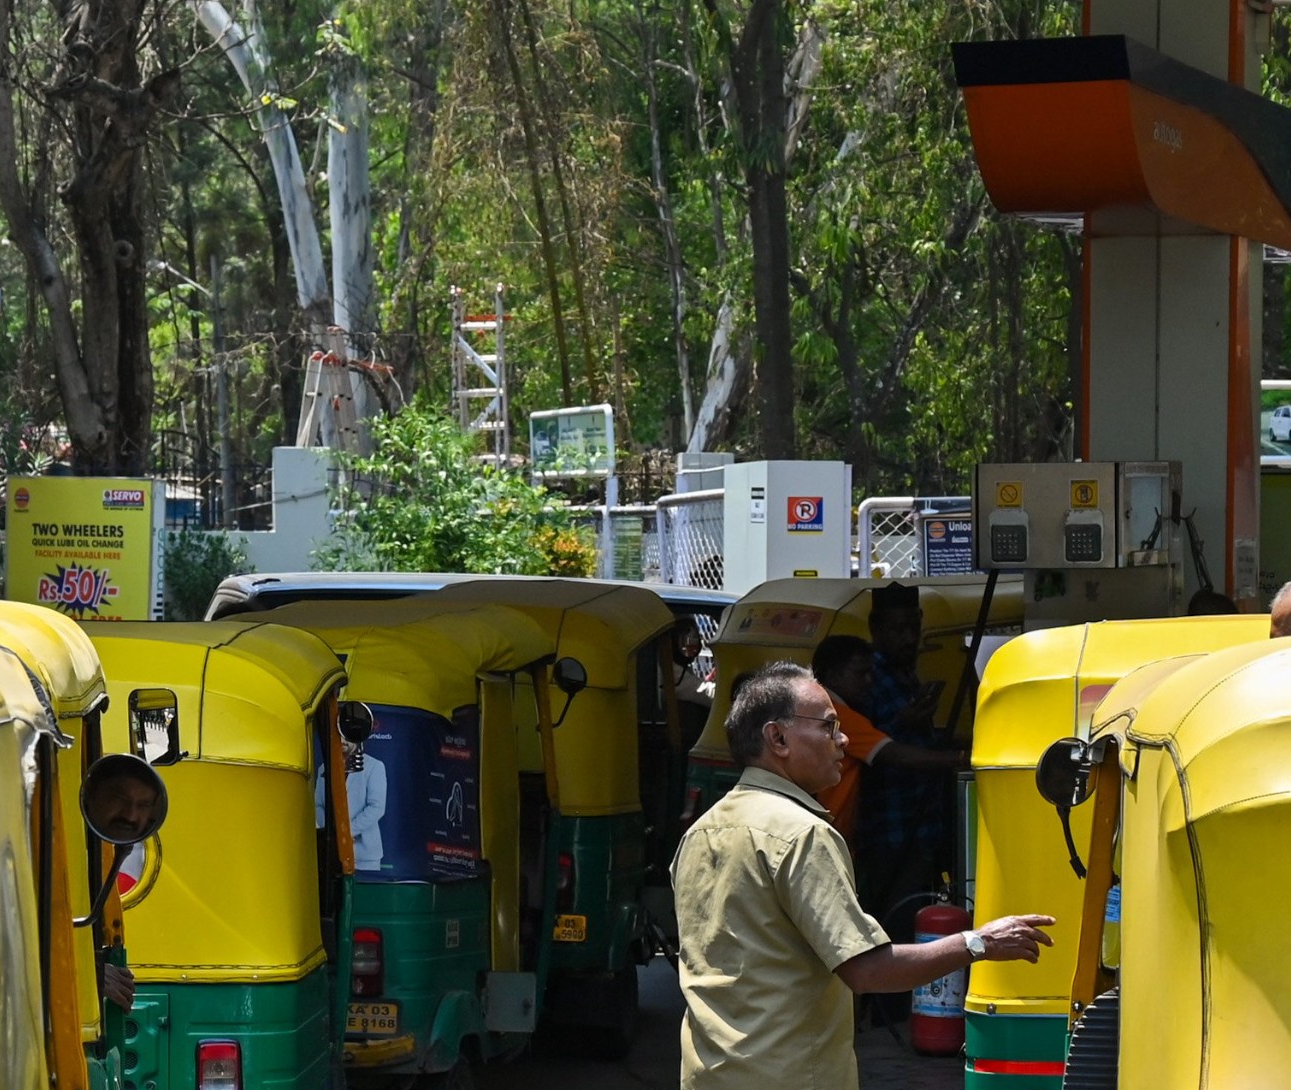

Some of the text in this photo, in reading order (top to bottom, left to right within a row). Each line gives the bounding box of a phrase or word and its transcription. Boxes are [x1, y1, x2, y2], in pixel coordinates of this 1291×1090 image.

[113, 490, 141, 501] SERVO
[32, 524, 124, 538] TWO WHEELERS
[32, 539, 124, 548] QUICK LUBE OIL CHANGE
[35, 550, 121, 560] FACILITY AVAILABLE HERE
[371, 1006, 389, 1016] 03
